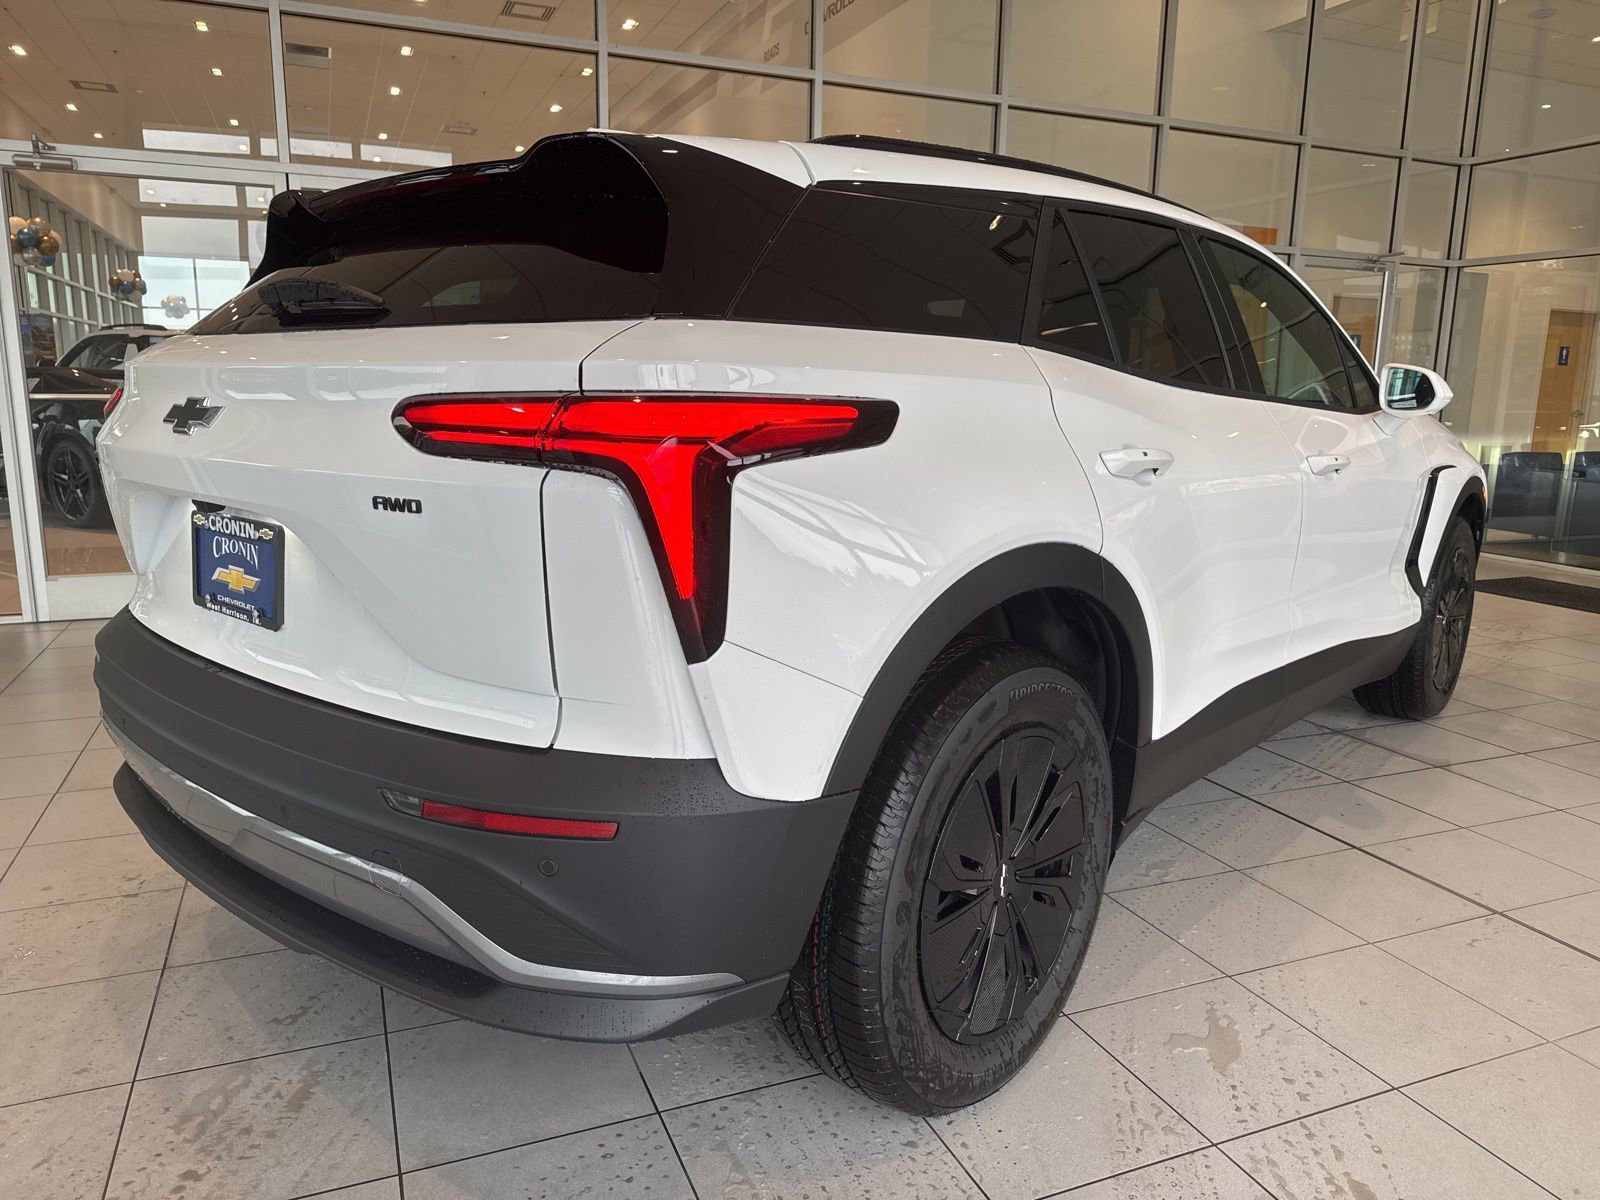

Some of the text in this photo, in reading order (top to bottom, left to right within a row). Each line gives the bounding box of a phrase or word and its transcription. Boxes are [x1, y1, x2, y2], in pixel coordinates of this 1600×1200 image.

[372, 495, 422, 514] AWD
[208, 515, 255, 540] CRONIN
[212, 535, 259, 570] CRONIN
[206, 602, 221, 612] West
[217, 594, 255, 611] CHEVROLET
